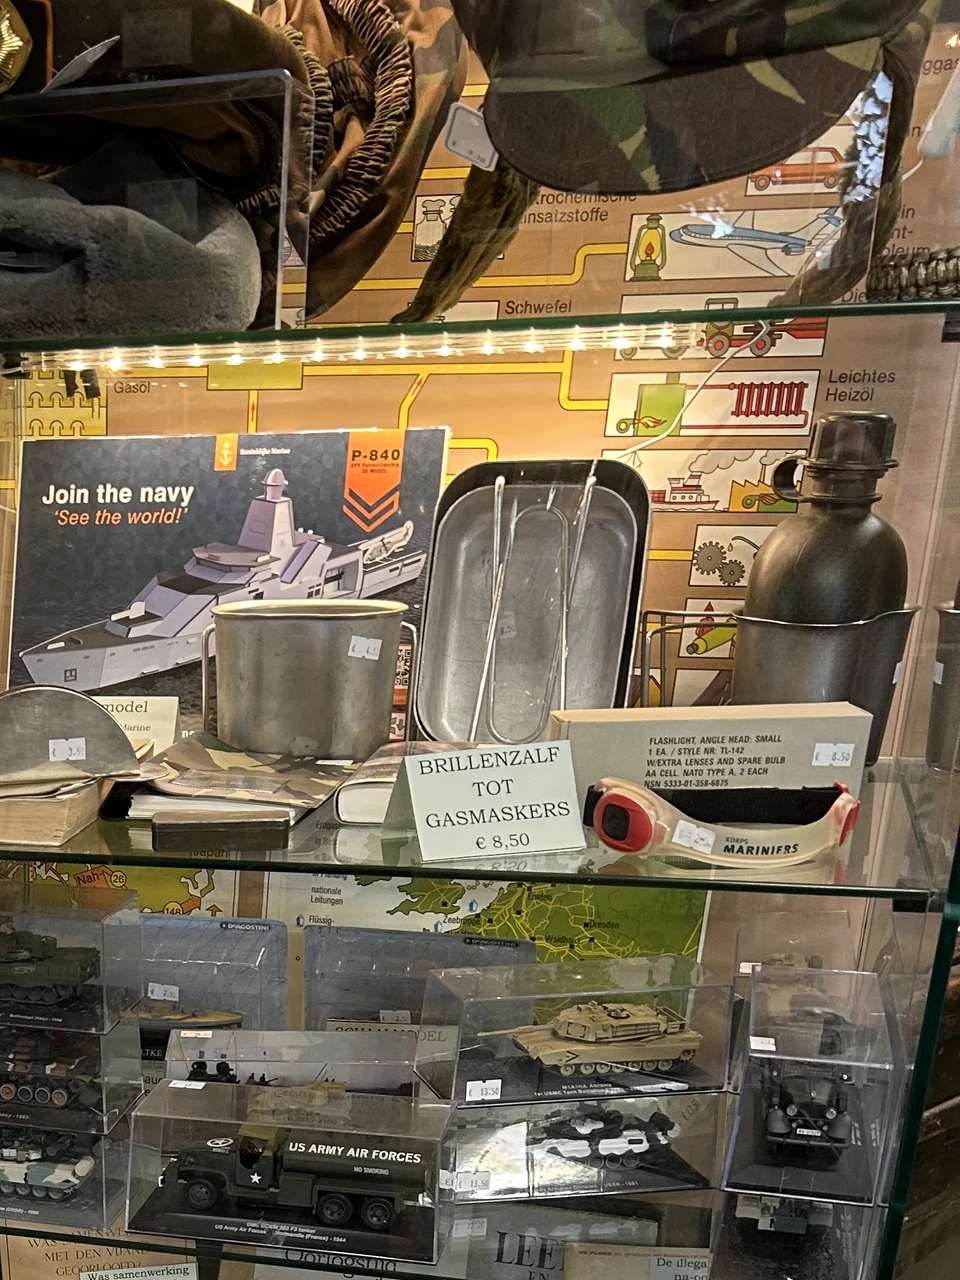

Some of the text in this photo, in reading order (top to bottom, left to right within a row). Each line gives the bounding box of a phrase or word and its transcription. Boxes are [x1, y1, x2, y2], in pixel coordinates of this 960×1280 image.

[504, 299, 572, 315] Schwefel
[828, 369, 896, 384] Leichtes
[113, 380, 151, 397] Gasöl
[825, 387, 874, 403] Heizöl
[351, 448, 401, 462] P-840
[41, 483, 194, 507] Join the navy
[95, 508, 122, 525] the
[649, 735, 782, 746] FLASHLIGHT, ANGLE HEAD: SMALL
[418, 746, 560, 775] BRILLENZALF
[647, 756, 786, 767] W/EXTRA LENSES AND SPARE BULB
[472, 778, 514, 797] TOT
[644, 778, 729, 789] NSN 5333-01-358-6875
[425, 801, 570, 829] GASMASKERS
[475, 833, 530, 851] € 8,50
[725, 836, 749, 845] KORPS
[77, 871, 104, 886] Nah-
[112, 874, 125, 884] 26
[311, 886, 342, 896] nationale
[310, 895, 344, 906] Leitungen
[308, 915, 335, 926] Flüssig-
[589, 920, 619, 930] Dresden
[289, 1141, 422, 1164] US ARMY AIR FORCES
[353, 1166, 389, 1176] NO SMOKING
[469, 1179, 489, 1188] 13.50
[44, 1251, 71, 1263] MET
[75, 1249, 102, 1260] DEN
[656, 1257, 707, 1270] De illega
[113, 1266, 190, 1280] samenwerking
